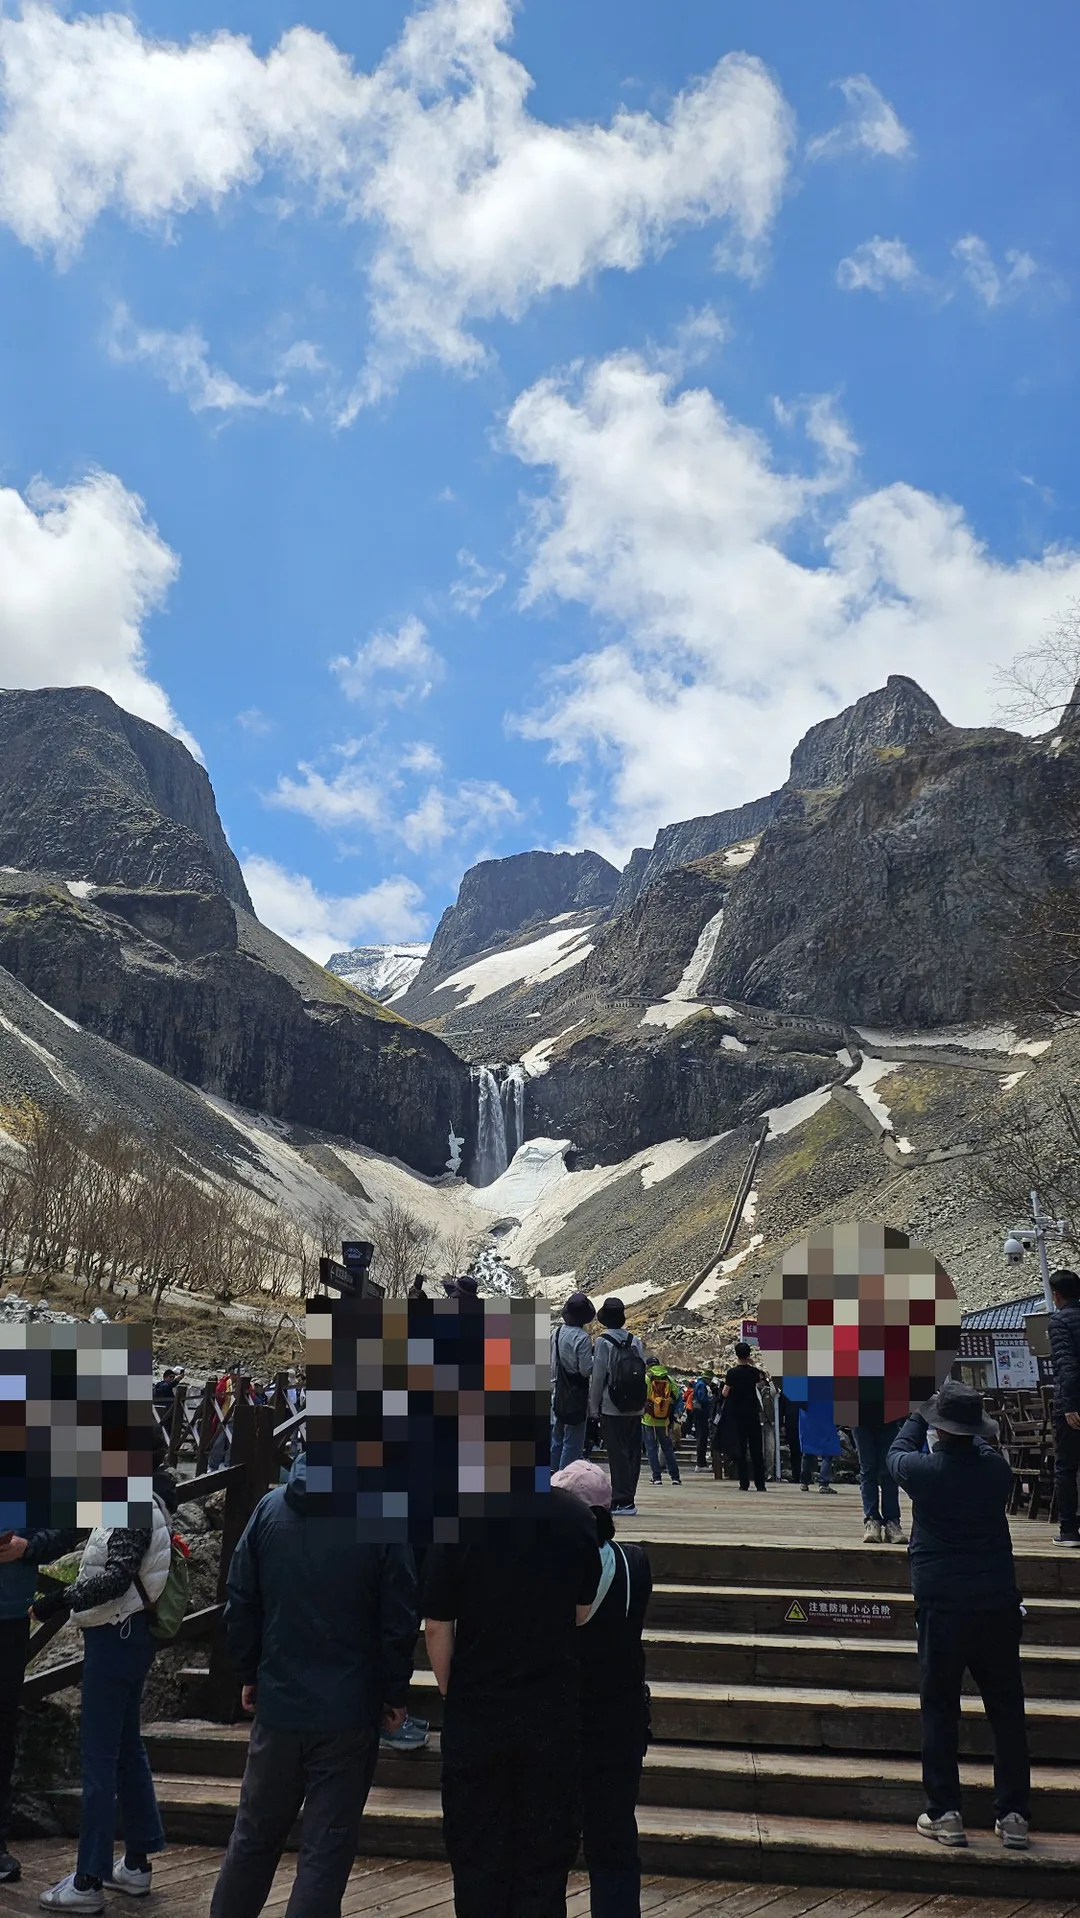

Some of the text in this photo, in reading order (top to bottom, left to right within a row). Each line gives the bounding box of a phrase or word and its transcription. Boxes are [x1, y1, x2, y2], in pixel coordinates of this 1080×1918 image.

[808, 1602, 891, 1615] 注意防滑 小心台阶
